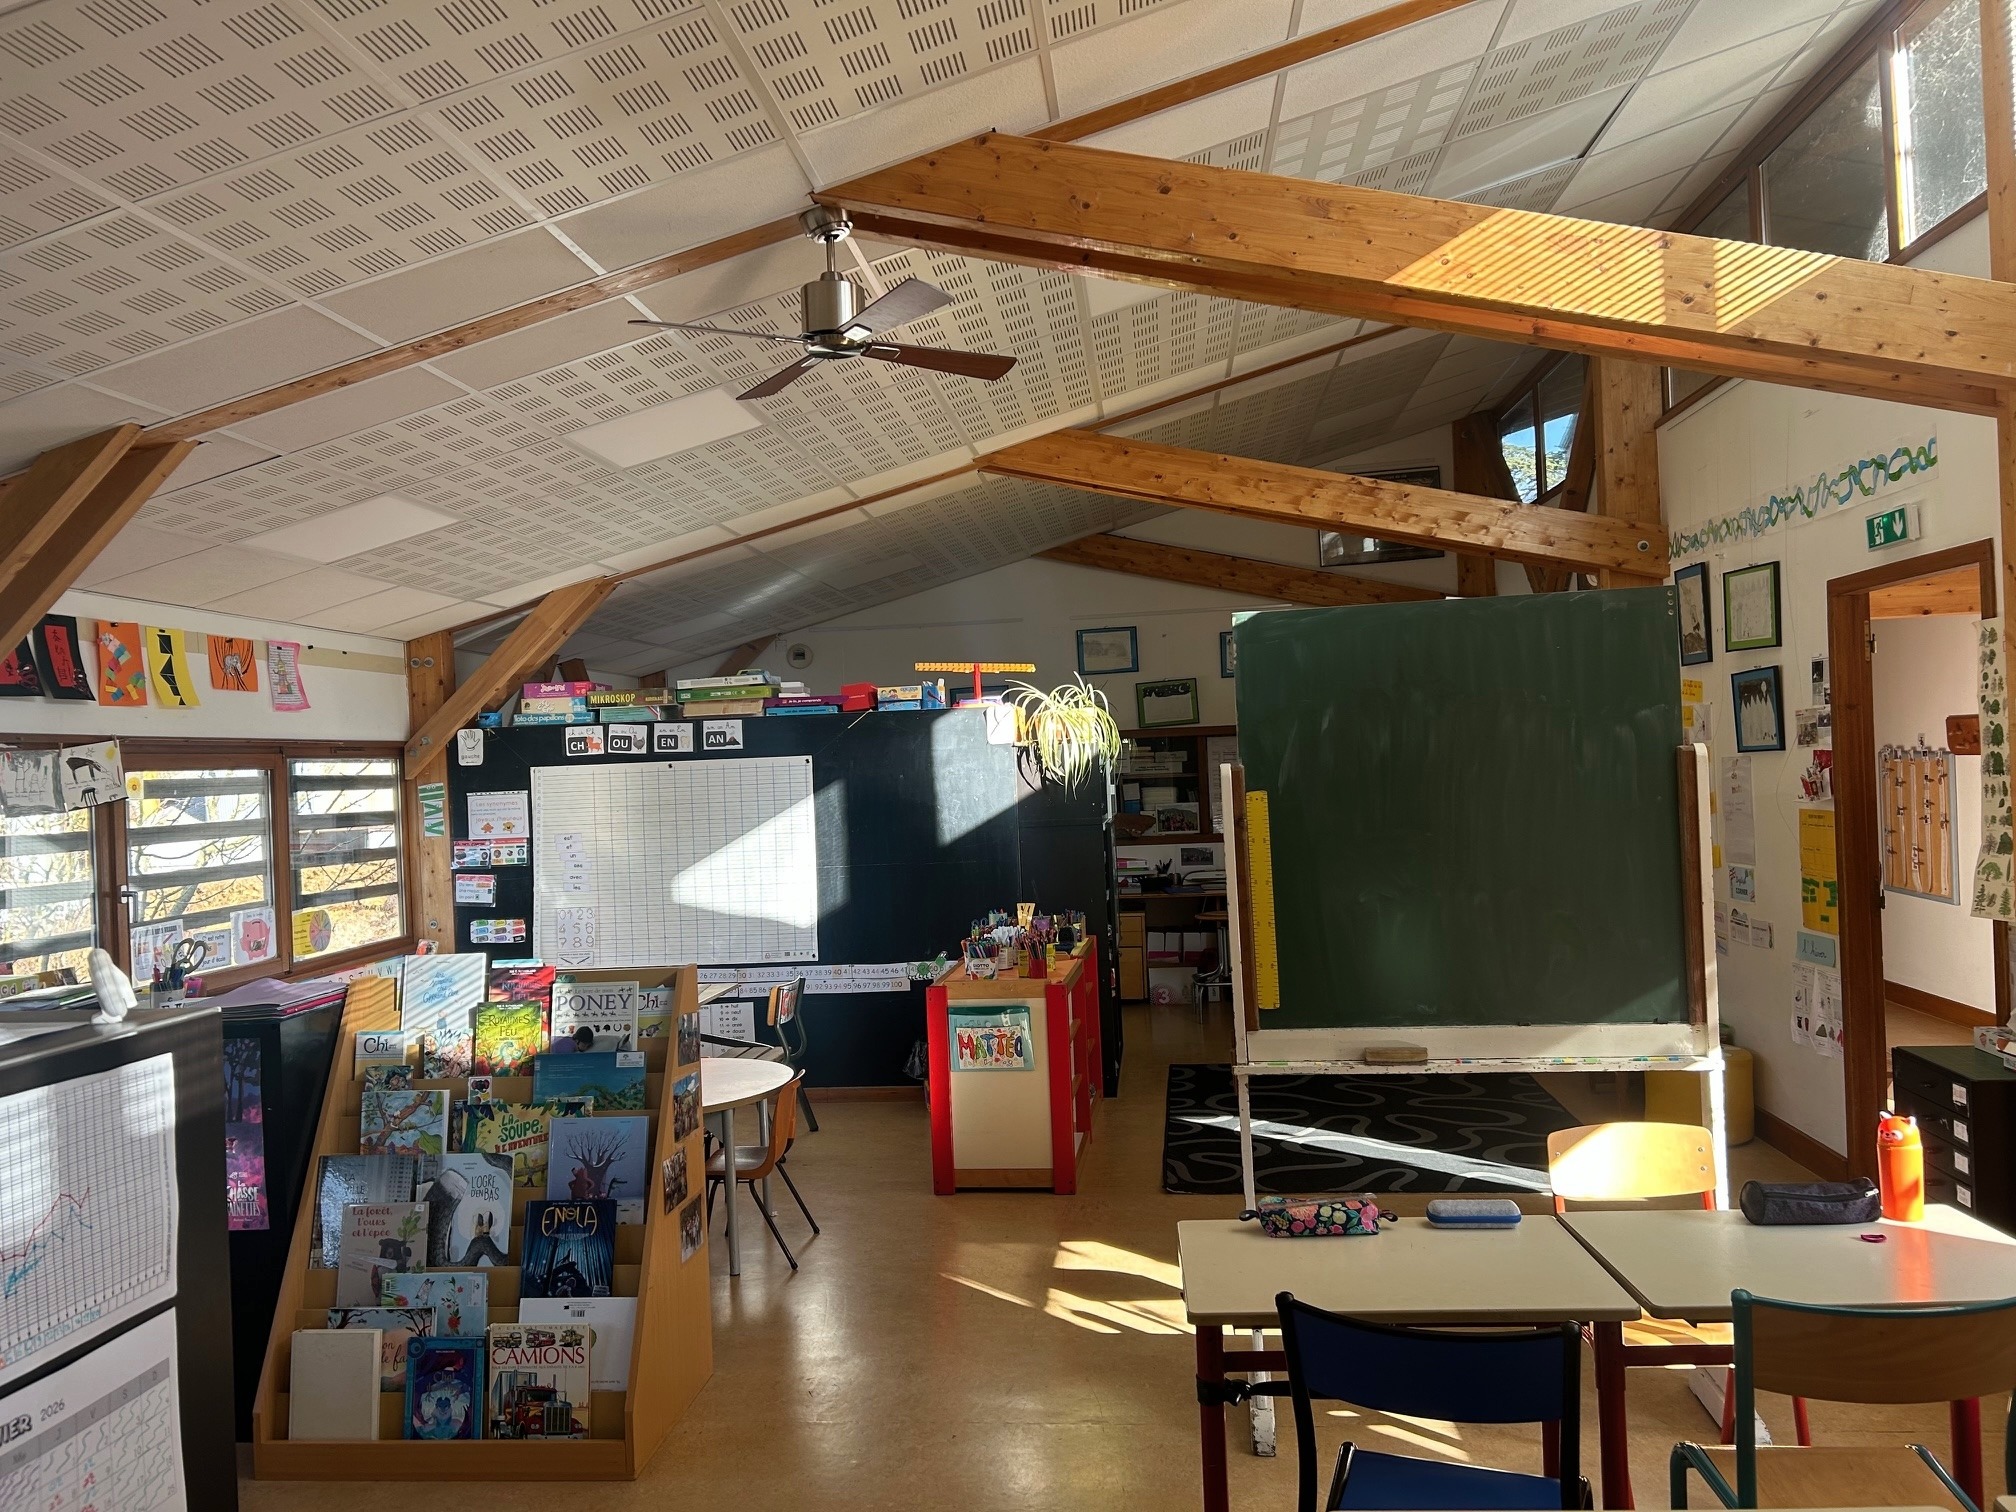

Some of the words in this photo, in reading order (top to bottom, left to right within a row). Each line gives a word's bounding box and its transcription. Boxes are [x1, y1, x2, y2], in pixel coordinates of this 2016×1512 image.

[590, 693, 636, 705] MIKROSKOP
[539, 713, 565, 724] papillons
[612, 739, 629, 749] OU
[661, 738, 675, 747] EN
[708, 734, 725, 744] AN
[571, 741, 585, 750] CH
[577, 909, 584, 920] 2
[587, 908, 594, 920] 3
[573, 922, 581, 934] 5
[585, 922, 594, 934] 6
[558, 937, 567, 948] 7
[573, 936, 582, 948] 8
[586, 936, 595, 948] 9
[202, 959, 211, 967] jour
[386, 965, 393, 975] W
[11, 984, 16, 995] d
[638, 992, 659, 1011] Chi
[1157, 988, 1171, 1004] 3
[556, 994, 633, 1011] PONEY
[364, 1036, 389, 1054] Chi
[502, 1114, 514, 1127] LA
[472, 1174, 496, 1189] L'OGRE
[471, 1189, 484, 1198] D'EN
[484, 1187, 500, 1203] BAS
[352, 1207, 365, 1216] La
[366, 1206, 393, 1218] forêt,
[358, 1218, 386, 1227] l'ours
[542, 1206, 598, 1237] ENOLA
[363, 1228, 391, 1239] l'épée
[382, 1342, 395, 1350] on
[393, 1344, 408, 1372] fa
[492, 1346, 585, 1365] CAMIONS
[41, 1401, 65, 1422] 2026
